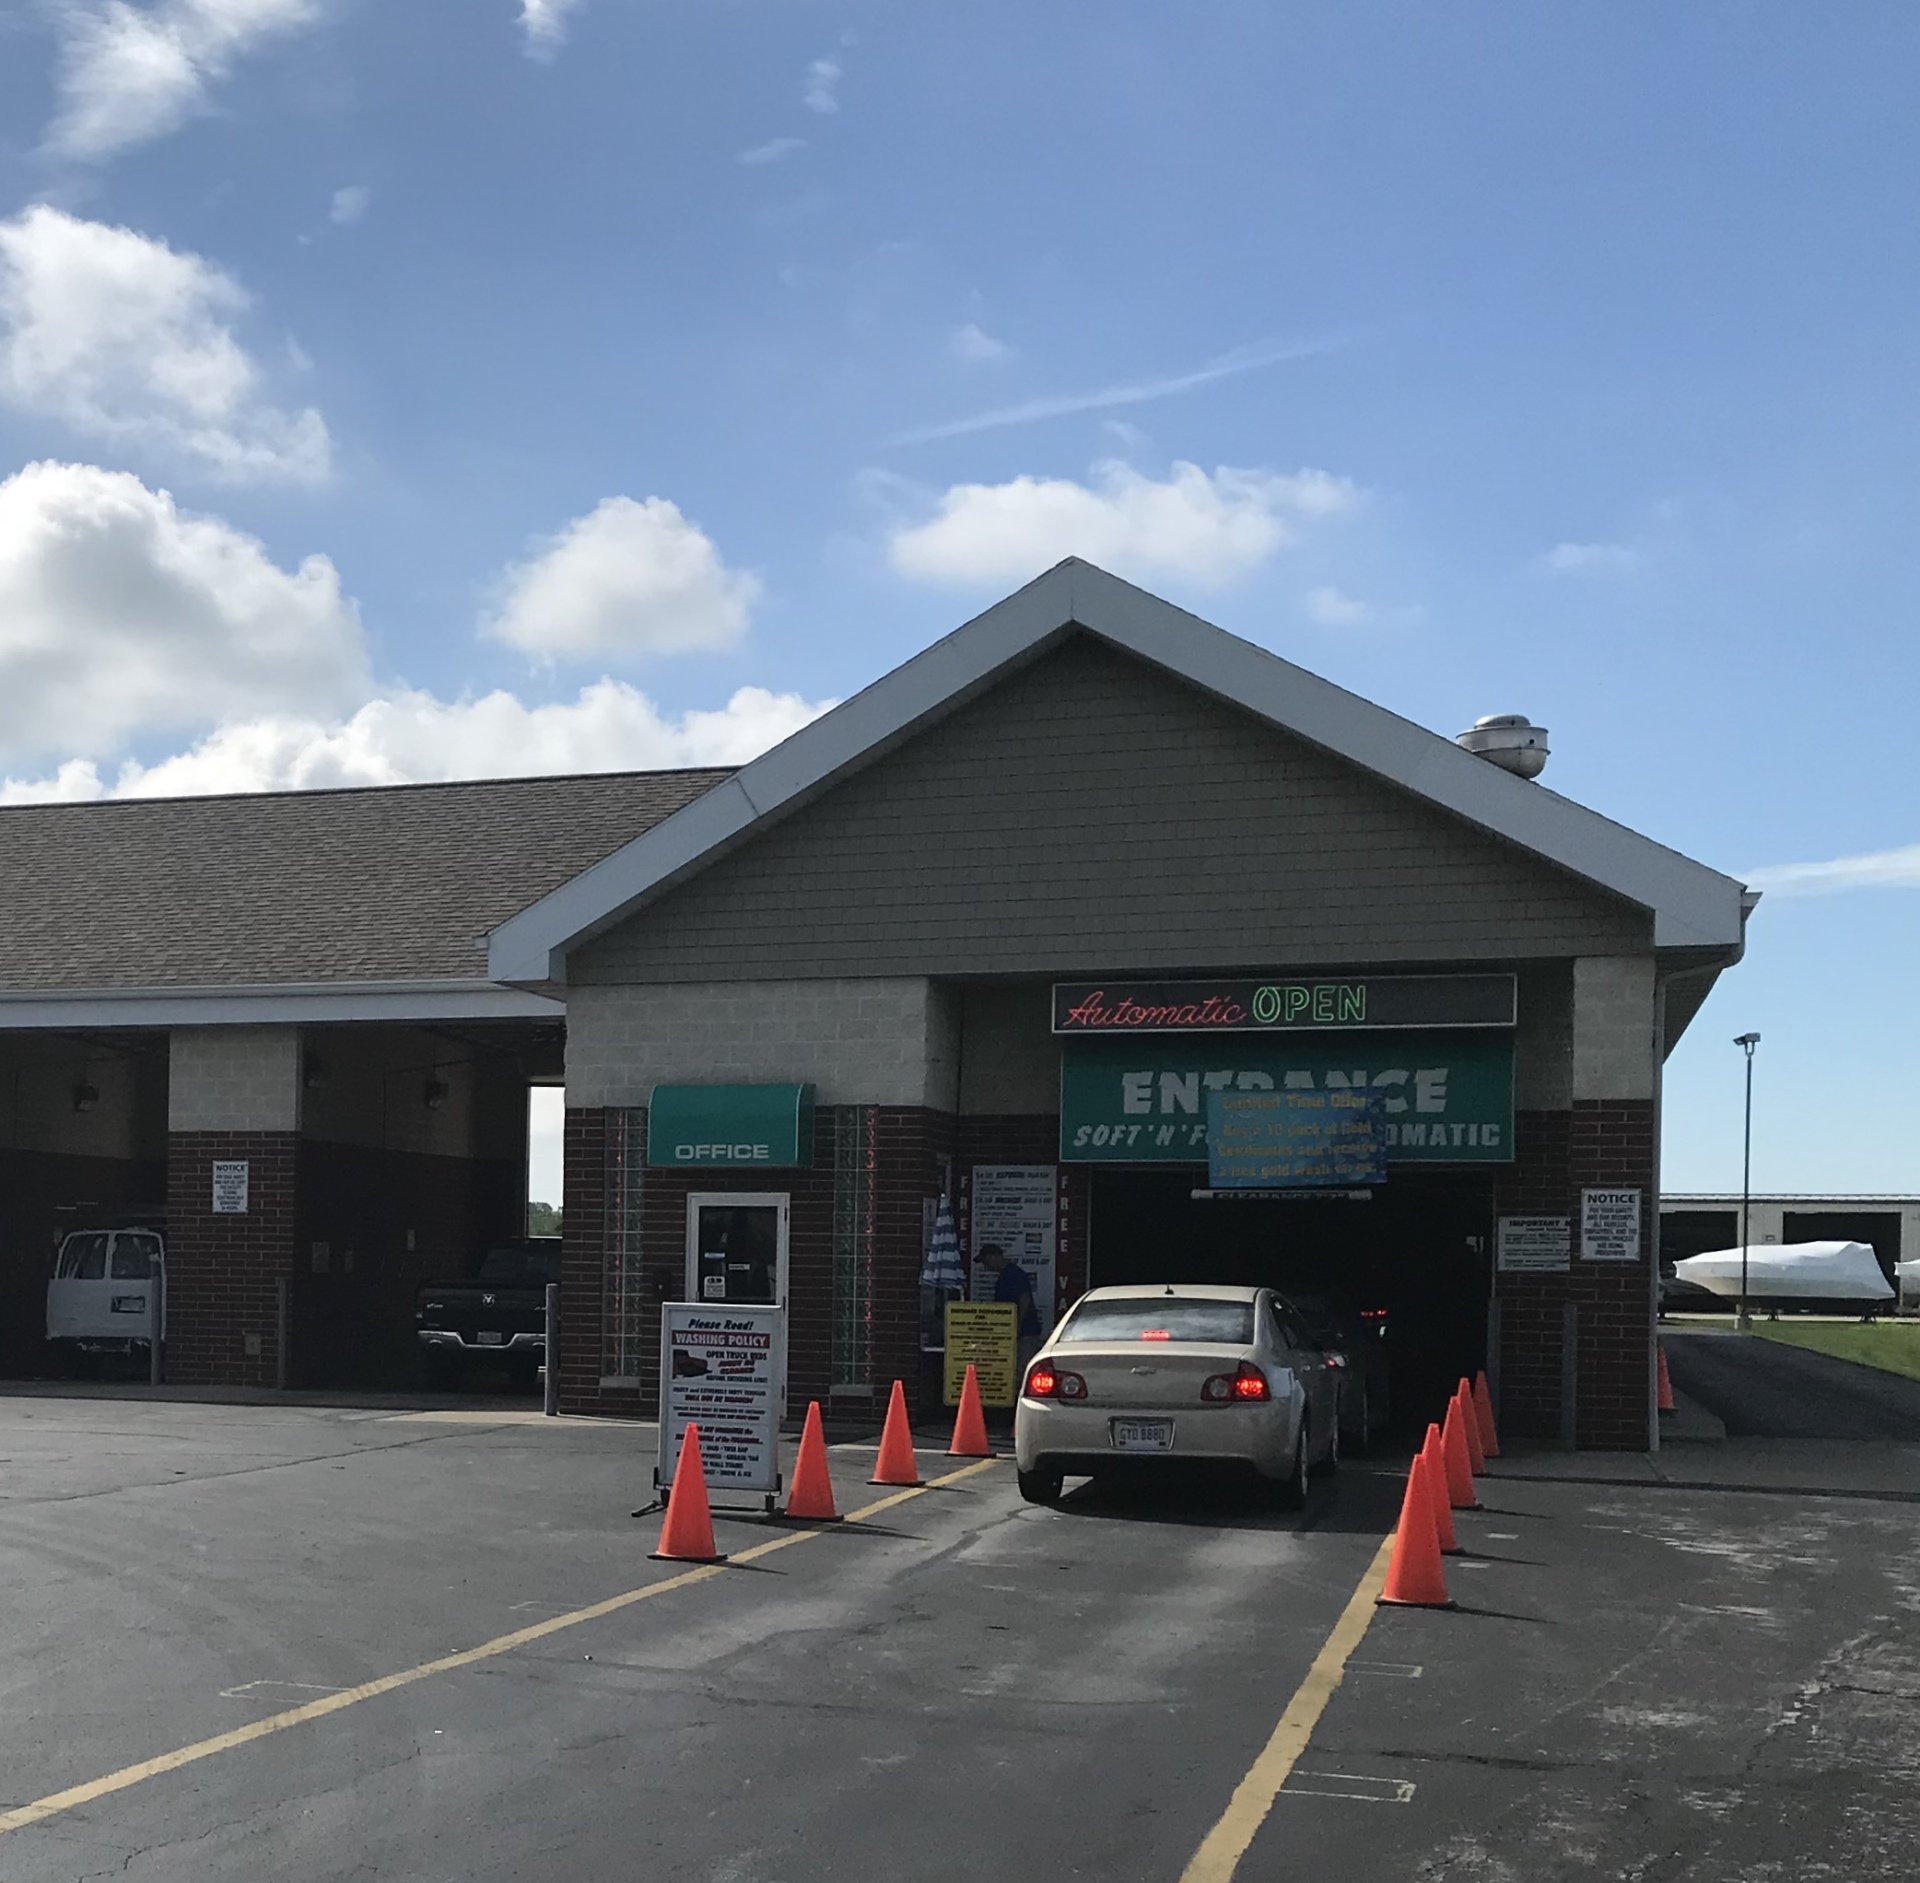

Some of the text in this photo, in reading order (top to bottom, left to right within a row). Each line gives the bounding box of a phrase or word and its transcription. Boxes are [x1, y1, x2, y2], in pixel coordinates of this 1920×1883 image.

[1063, 985, 1367, 1026] Automatic OPEN
[1385, 1123, 1501, 1146] OMATIC
[675, 1144, 770, 1160] OFFICE
[216, 1164, 245, 1172] NOTICE
[1587, 1193, 1637, 1204] NOTICE
[688, 1318, 754, 1331] Please Read!
[675, 1333, 767, 1347] WASHING POLICY
[706, 1350, 725, 1359] OPEN
[726, 1350, 748, 1361] TRUCK
